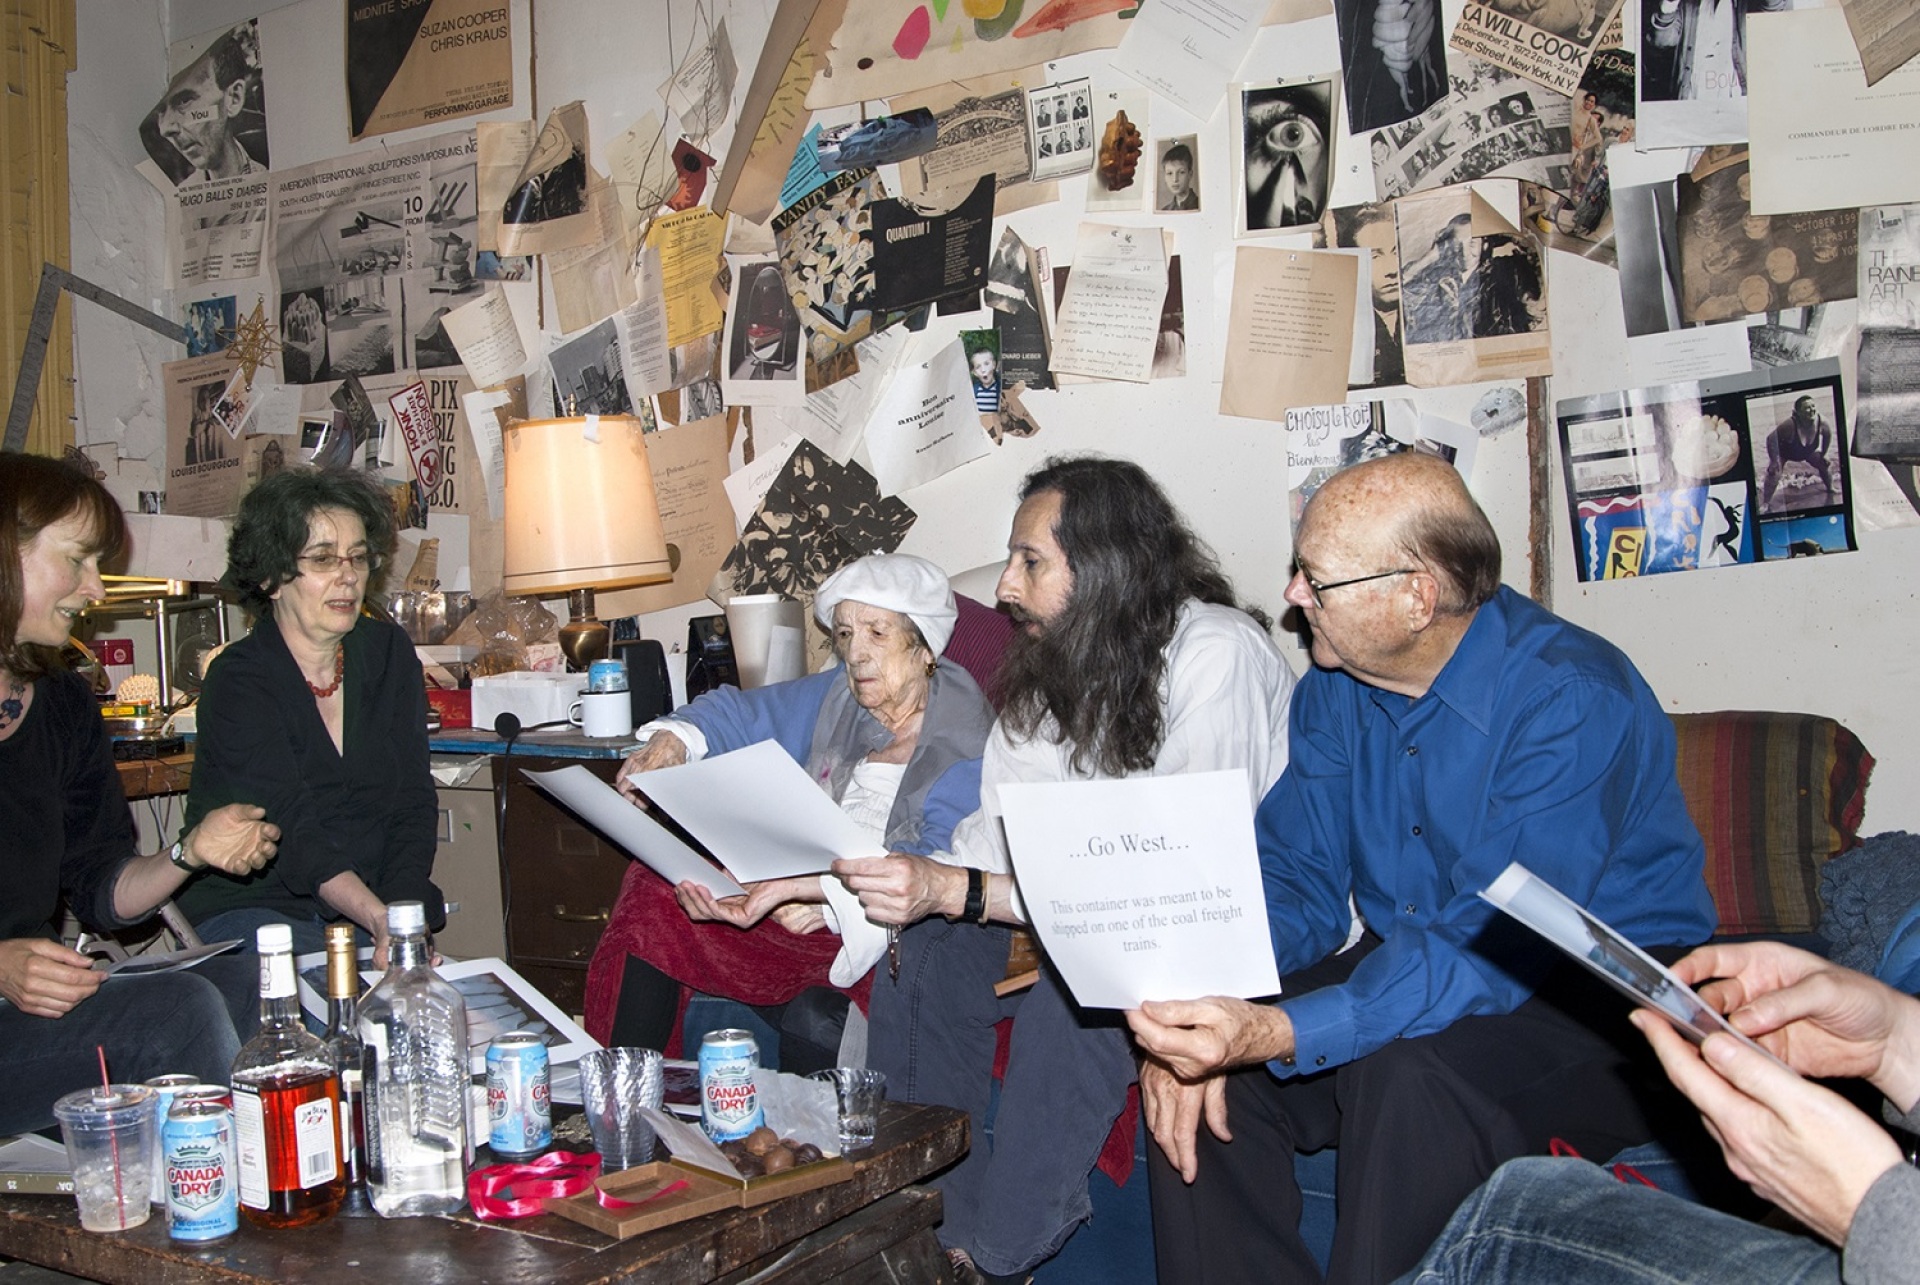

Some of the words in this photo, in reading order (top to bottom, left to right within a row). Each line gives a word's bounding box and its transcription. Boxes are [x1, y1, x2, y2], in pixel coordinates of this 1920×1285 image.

[353, 1, 396, 22] MIDNITE
[421, 23, 455, 38] SUZAN
[457, 8, 507, 29] COOPER
[431, 35, 464, 53] CHRIS
[466, 26, 507, 45] KRAUS
[1462, 23, 1501, 46] December
[1513, 44, 1532, 58] 1972
[1485, 11, 1524, 43] WILL
[1530, 31, 1588, 68] COOK
[1475, 41, 1506, 62] Street
[1507, 55, 1531, 73] New
[191, 110, 209, 120] You
[424, 101, 475, 120] PERFORMING
[475, 93, 509, 110] GARAGE
[1788, 128, 1848, 140] COMMANDEUR
[1899, 122, 1915, 130] DES
[278, 178, 312, 193] AMERICAN
[311, 166, 366, 184] INTERNATIONAL
[368, 155, 412, 174] SCULPTORS
[180, 193, 203, 207] HUGO
[236, 182, 267, 198] DIARIES
[404, 196, 423, 214] 10
[777, 187, 829, 228] VANITY
[835, 166, 872, 191] FAIR
[405, 217, 423, 226] FROM
[886, 221, 925, 244] QUANTUM
[1795, 217, 1836, 233] OCTOBER
[1839, 213, 1857, 225] 199
[1869, 282, 1909, 299] ART
[430, 380, 458, 410] PIX
[922, 394, 938, 407] Bon
[898, 394, 956, 426] anniversaire
[918, 411, 944, 430] Louise
[398, 408, 421, 452] HONK
[433, 412, 455, 442] BIZ
[171, 465, 197, 478] LOUISE
[197, 457, 239, 473] BOURGEOIS
[1050, 900, 1074, 915] This
[1076, 897, 1128, 913] container
[1132, 896, 1155, 908] was
[1159, 889, 1197, 906] meant
[1201, 889, 1213, 901] to
[1216, 886, 1232, 899] be
[1052, 922, 1089, 940] shipped
[1091, 923, 1105, 934] on
[1107, 920, 1129, 932] one
[1132, 915, 1146, 930] of
[1148, 913, 1168, 928] the
[1171, 909, 1198, 925] coal
[1201, 904, 1243, 924] freight
[1123, 939, 1161, 953] trains.
[707, 1083, 756, 1100] CANADA
[720, 1098, 746, 1110] DRY
[167, 1166, 225, 1184] CANADA
[181, 1182, 211, 1196] DRY
